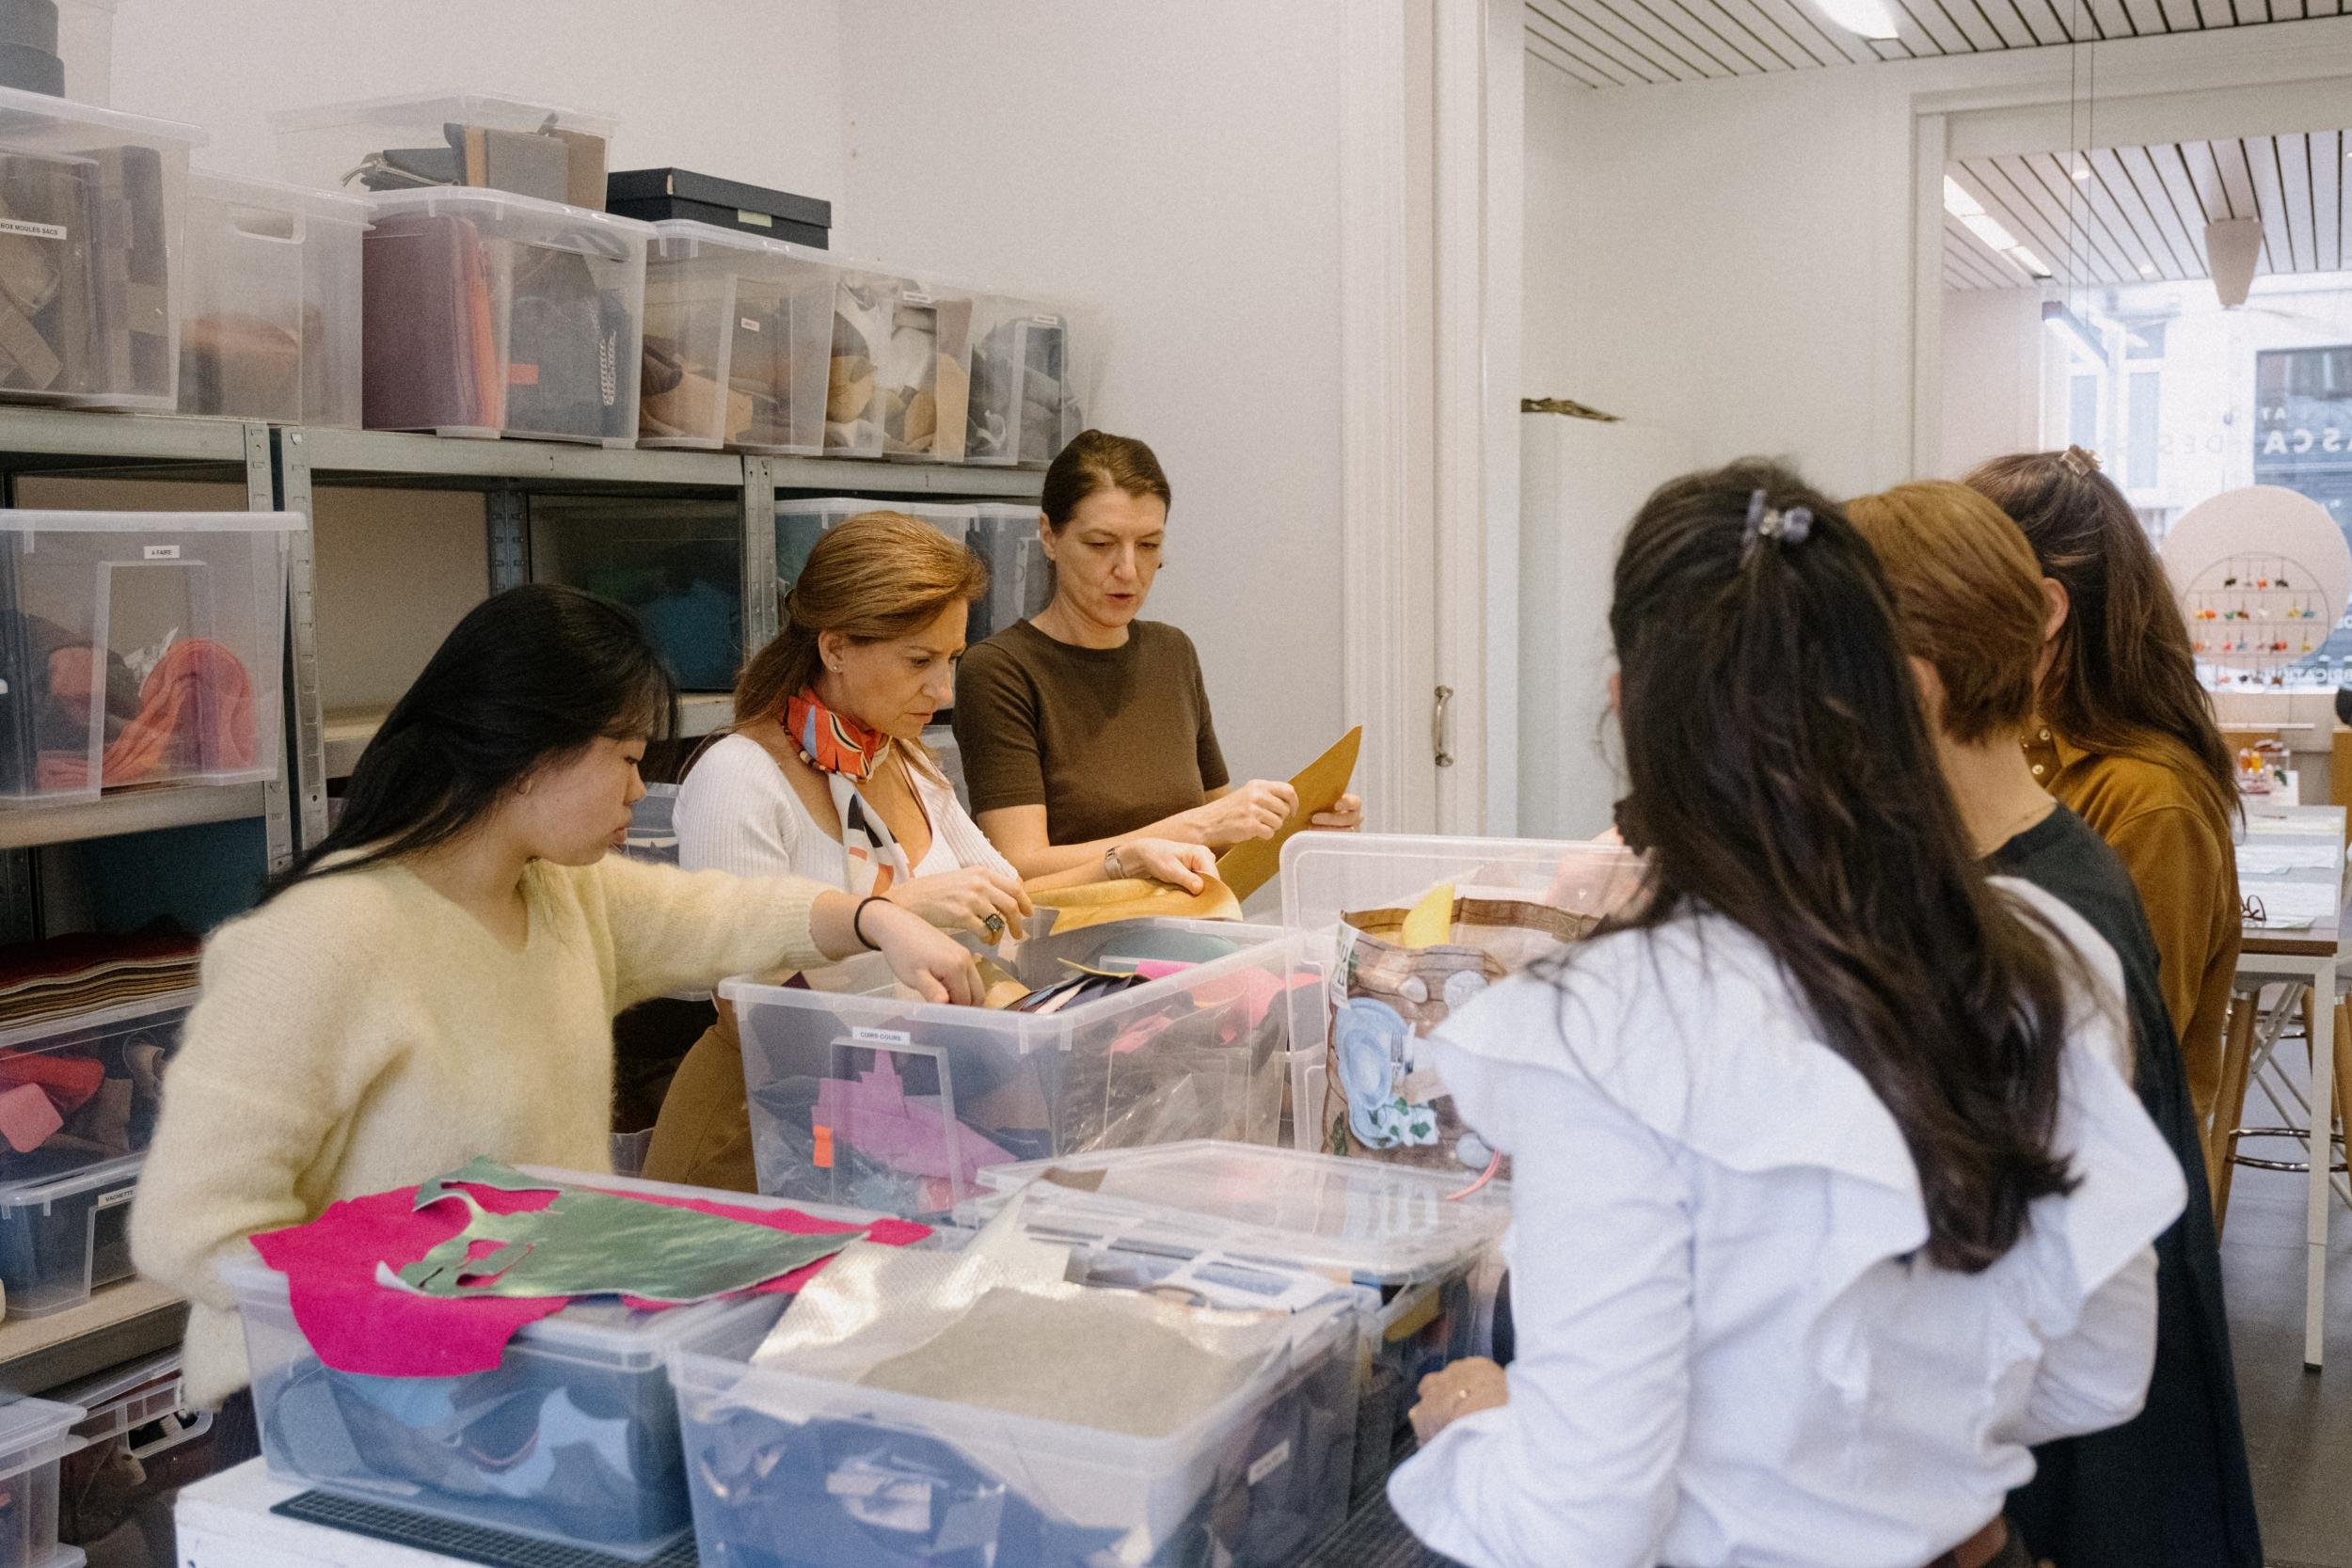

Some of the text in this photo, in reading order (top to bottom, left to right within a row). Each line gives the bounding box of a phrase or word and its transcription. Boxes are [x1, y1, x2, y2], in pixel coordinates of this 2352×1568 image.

[0, 222, 58, 236] BOX MOULES SACS
[880, 1033, 901, 1042] COURS
